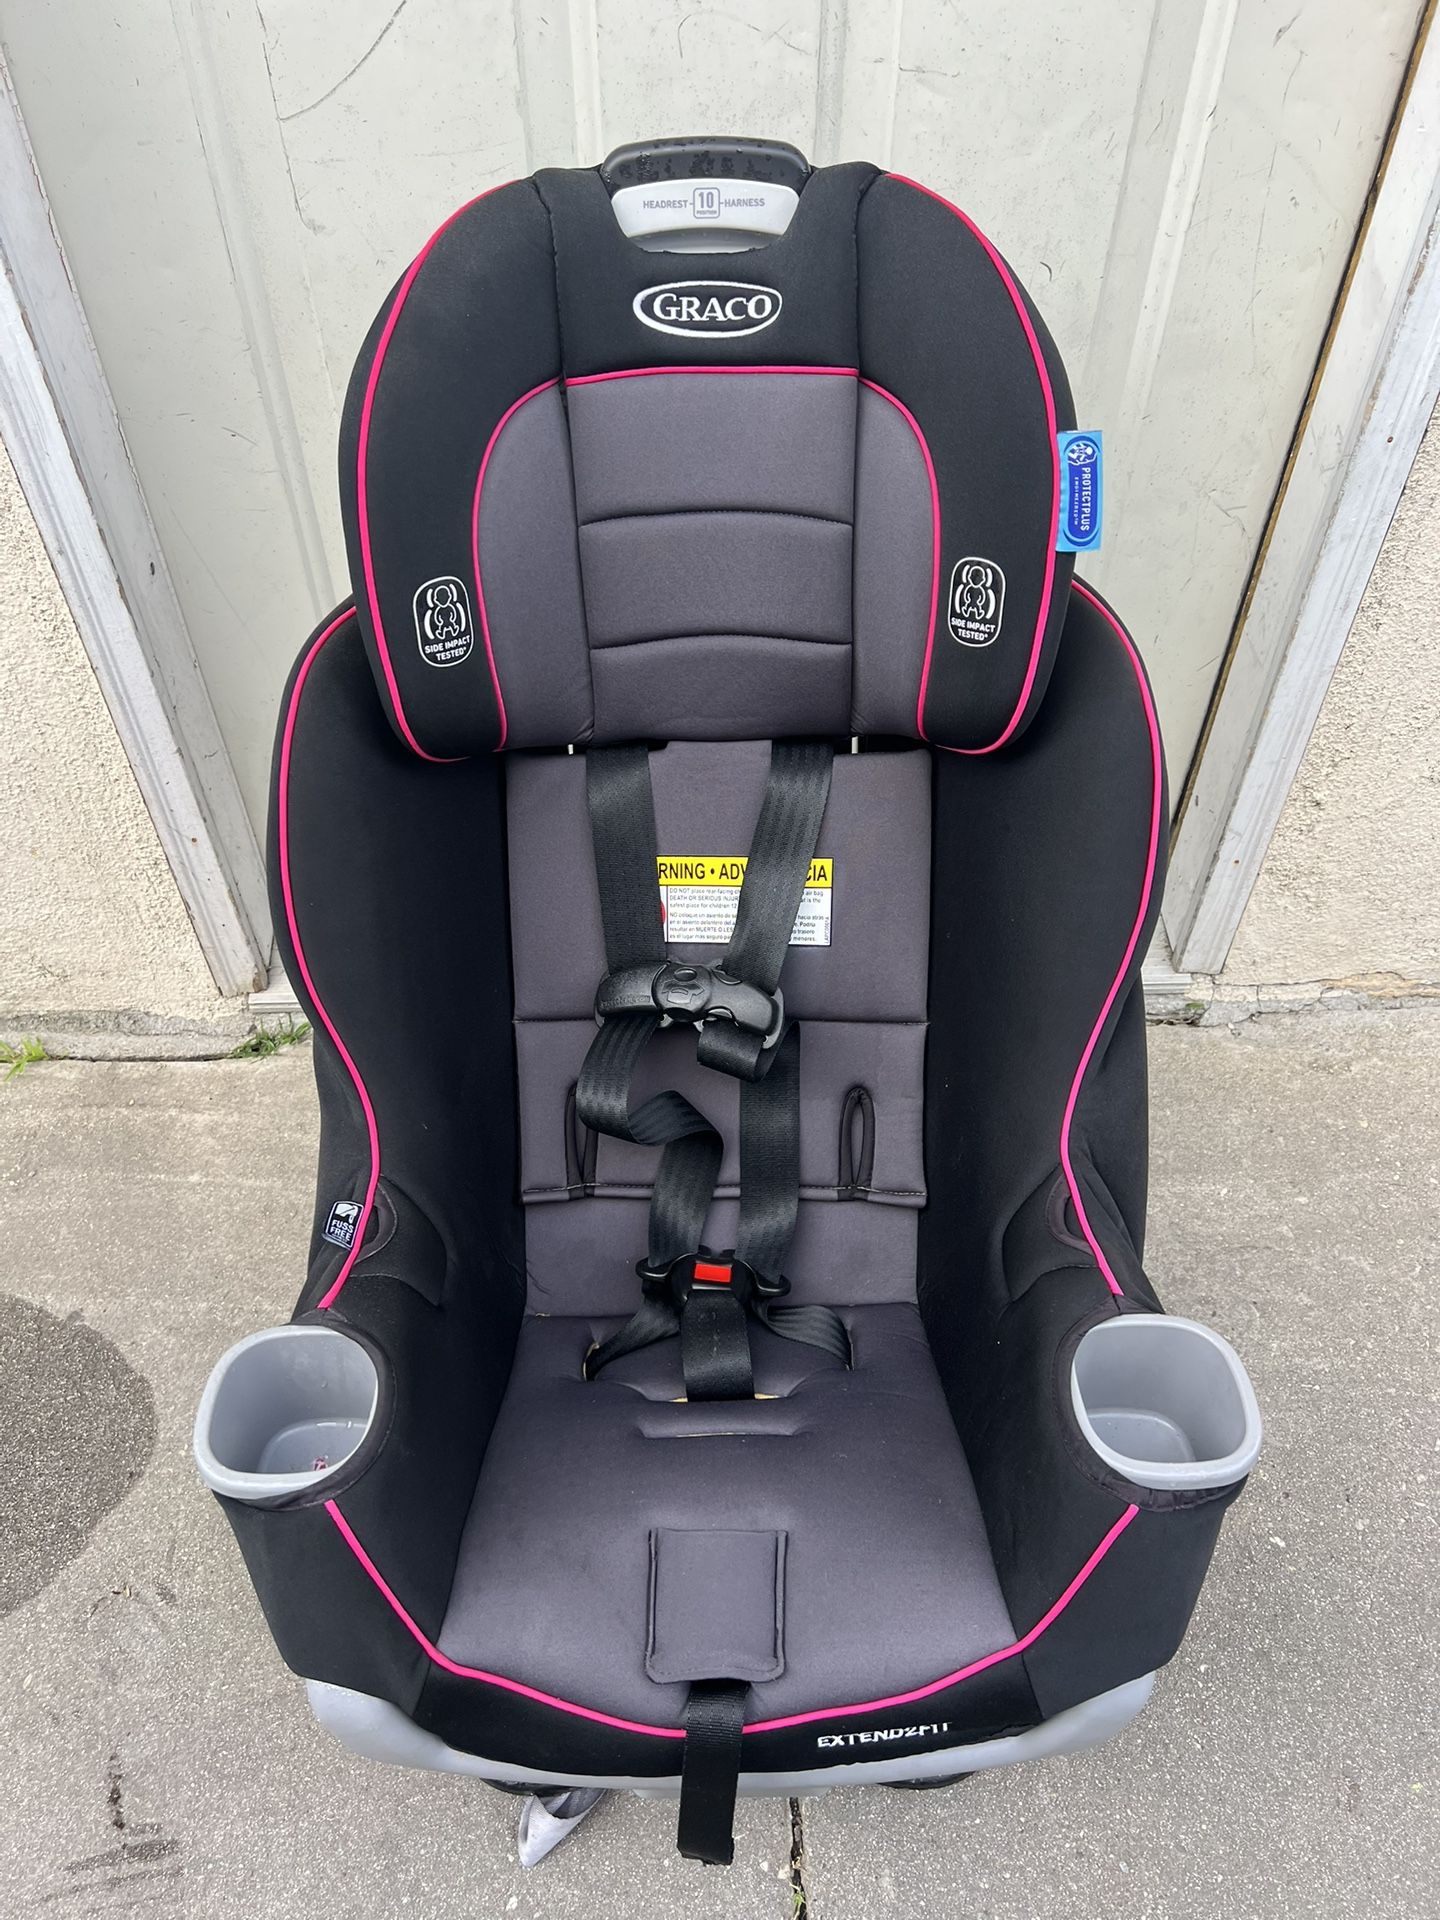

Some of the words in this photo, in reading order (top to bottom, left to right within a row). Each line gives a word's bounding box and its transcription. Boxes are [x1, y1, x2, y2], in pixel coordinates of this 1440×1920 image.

[642, 200, 688, 209] HEADREST
[698, 191, 714, 209] 10
[724, 198, 766, 208] HARNESS
[653, 293, 773, 322] GRACO
[1080, 467, 1091, 531] PROTECTPLUS
[951, 617, 966, 628] SIDE
[967, 621, 996, 633] IMPACT
[424, 643, 444, 654] SIDE
[444, 635, 471, 650] IMPACT
[658, 863, 705, 880] RNING
[330, 1226, 352, 1241] FREE
[331, 1219, 354, 1233] FUSS
